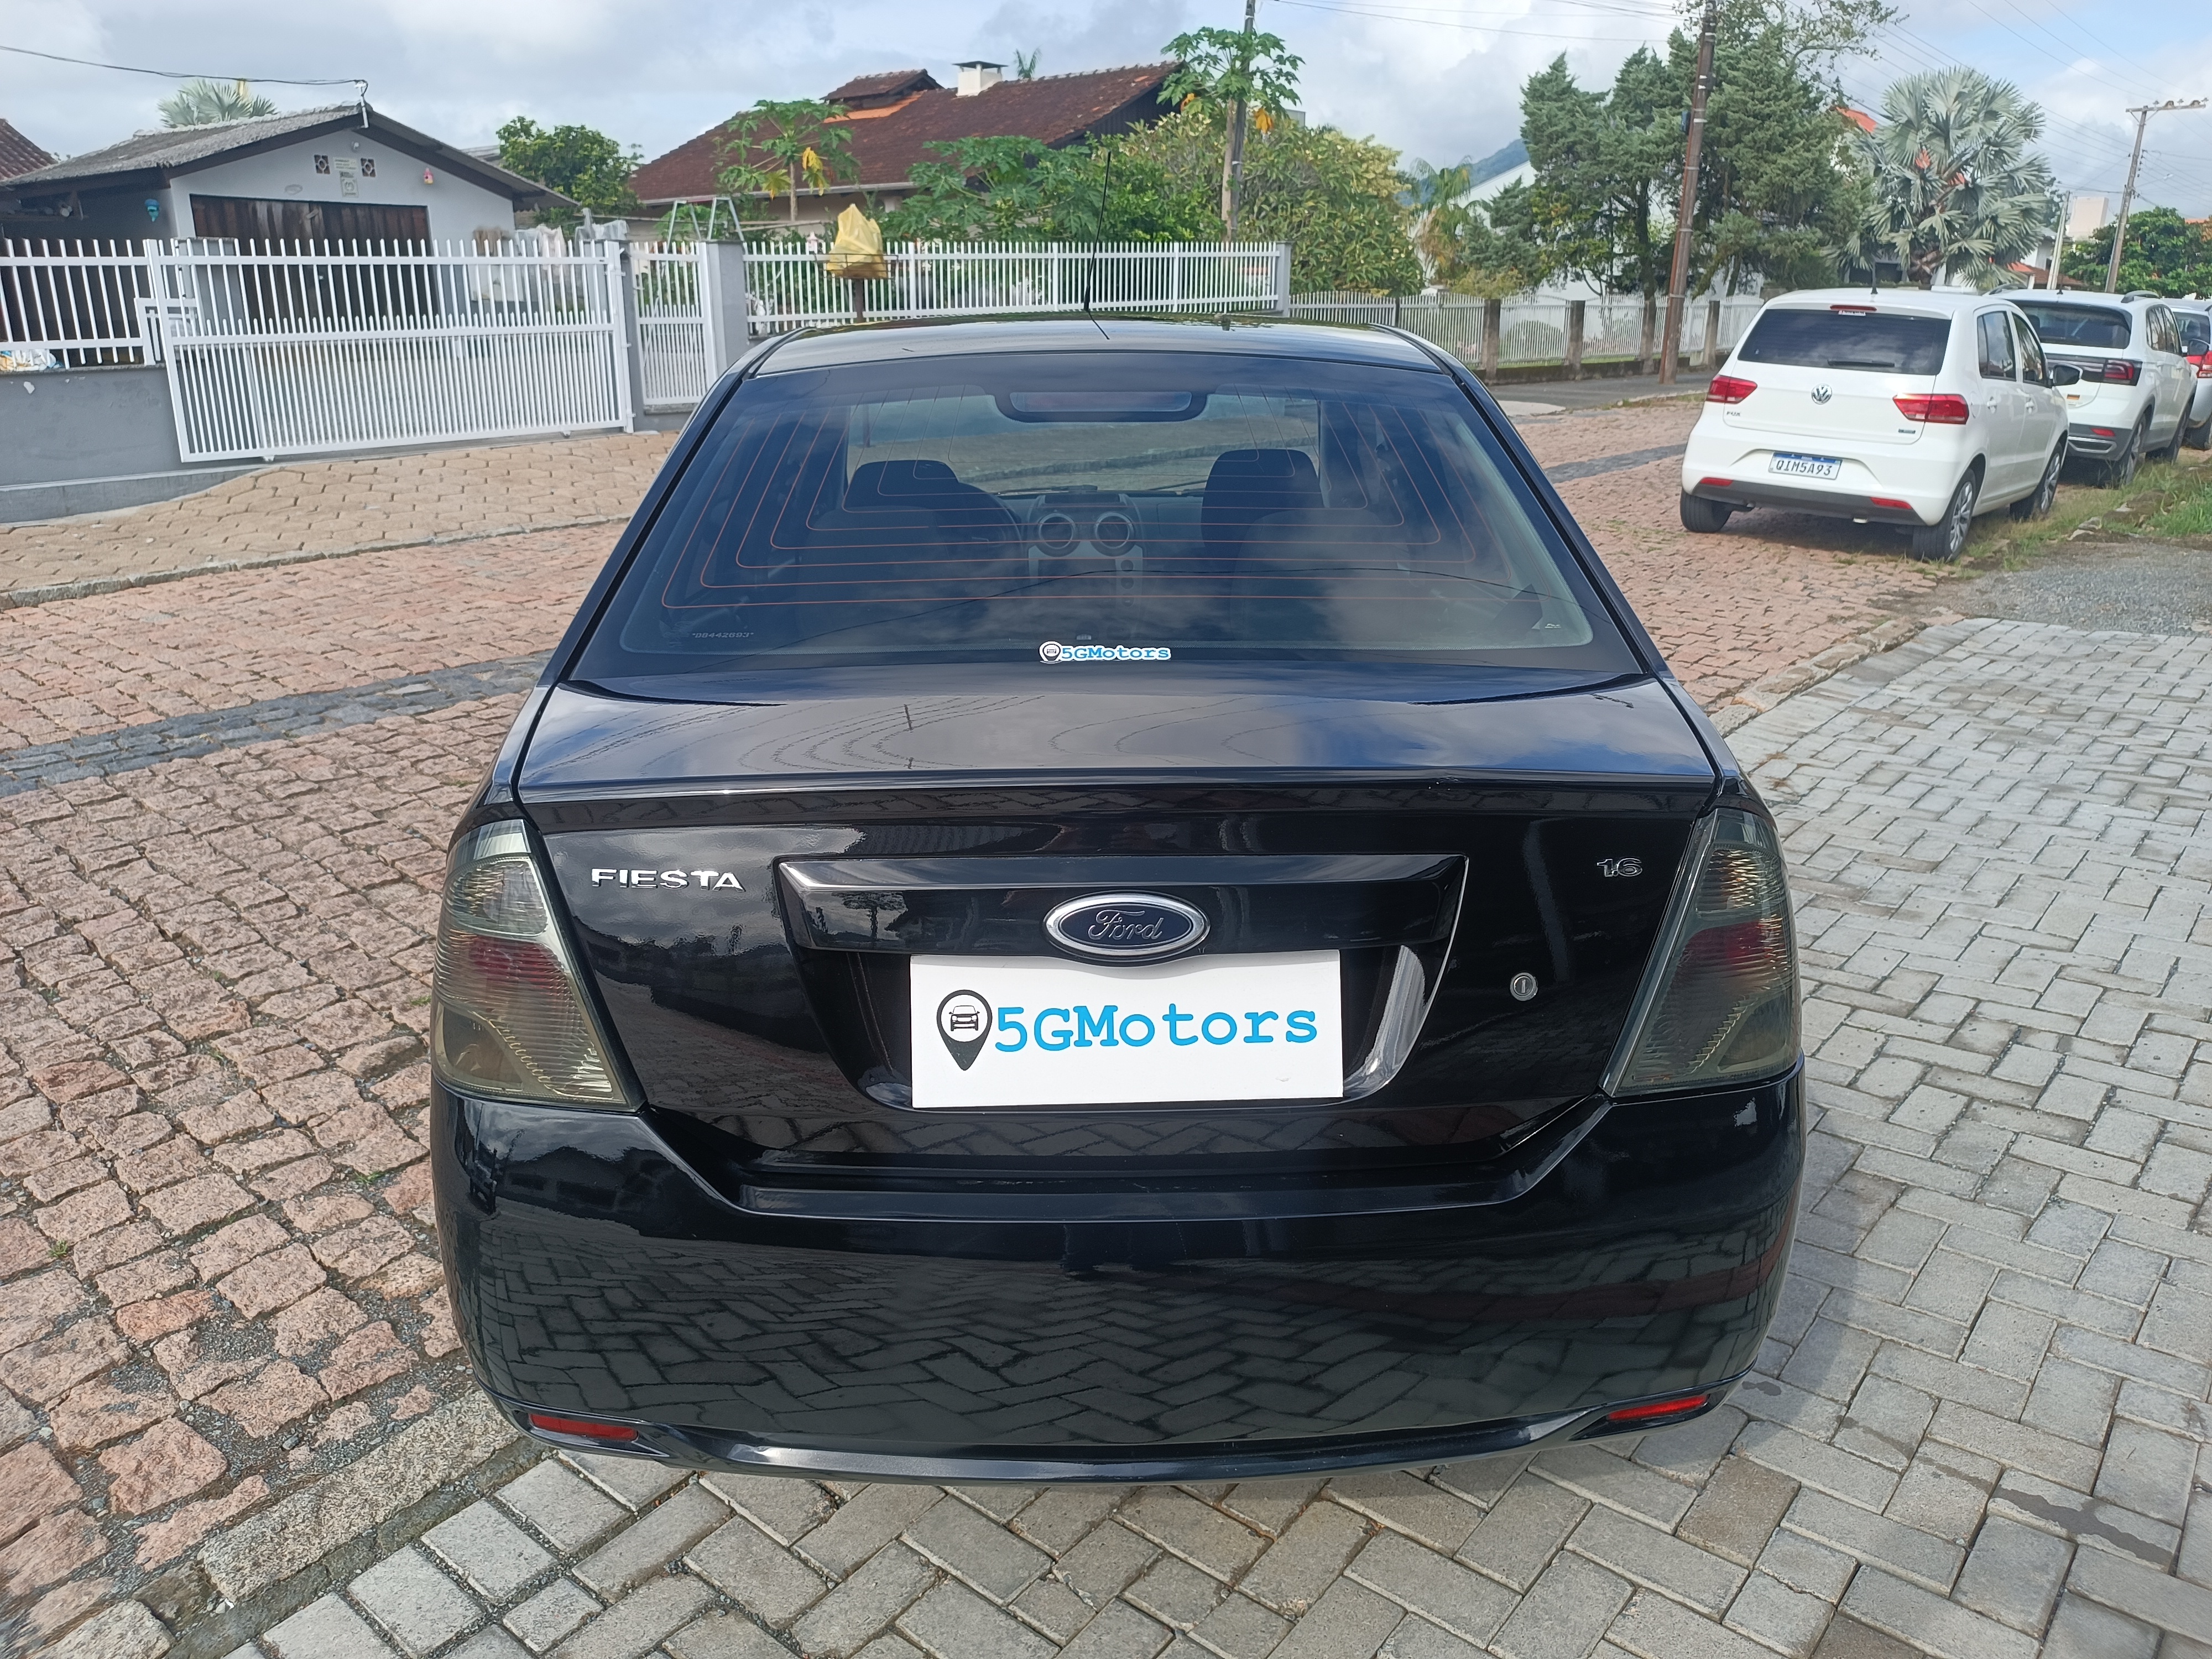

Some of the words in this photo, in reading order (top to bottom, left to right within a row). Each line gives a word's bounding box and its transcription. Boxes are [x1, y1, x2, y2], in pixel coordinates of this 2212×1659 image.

[1776, 460, 1832, 476] QIM5A93
[1062, 647, 1169, 659] 5GMotors
[1597, 858, 1642, 877] 1.6
[591, 868, 746, 893] FIESTA
[1088, 909, 1164, 940] Ford
[995, 1003, 1318, 1053] 5GMotors
